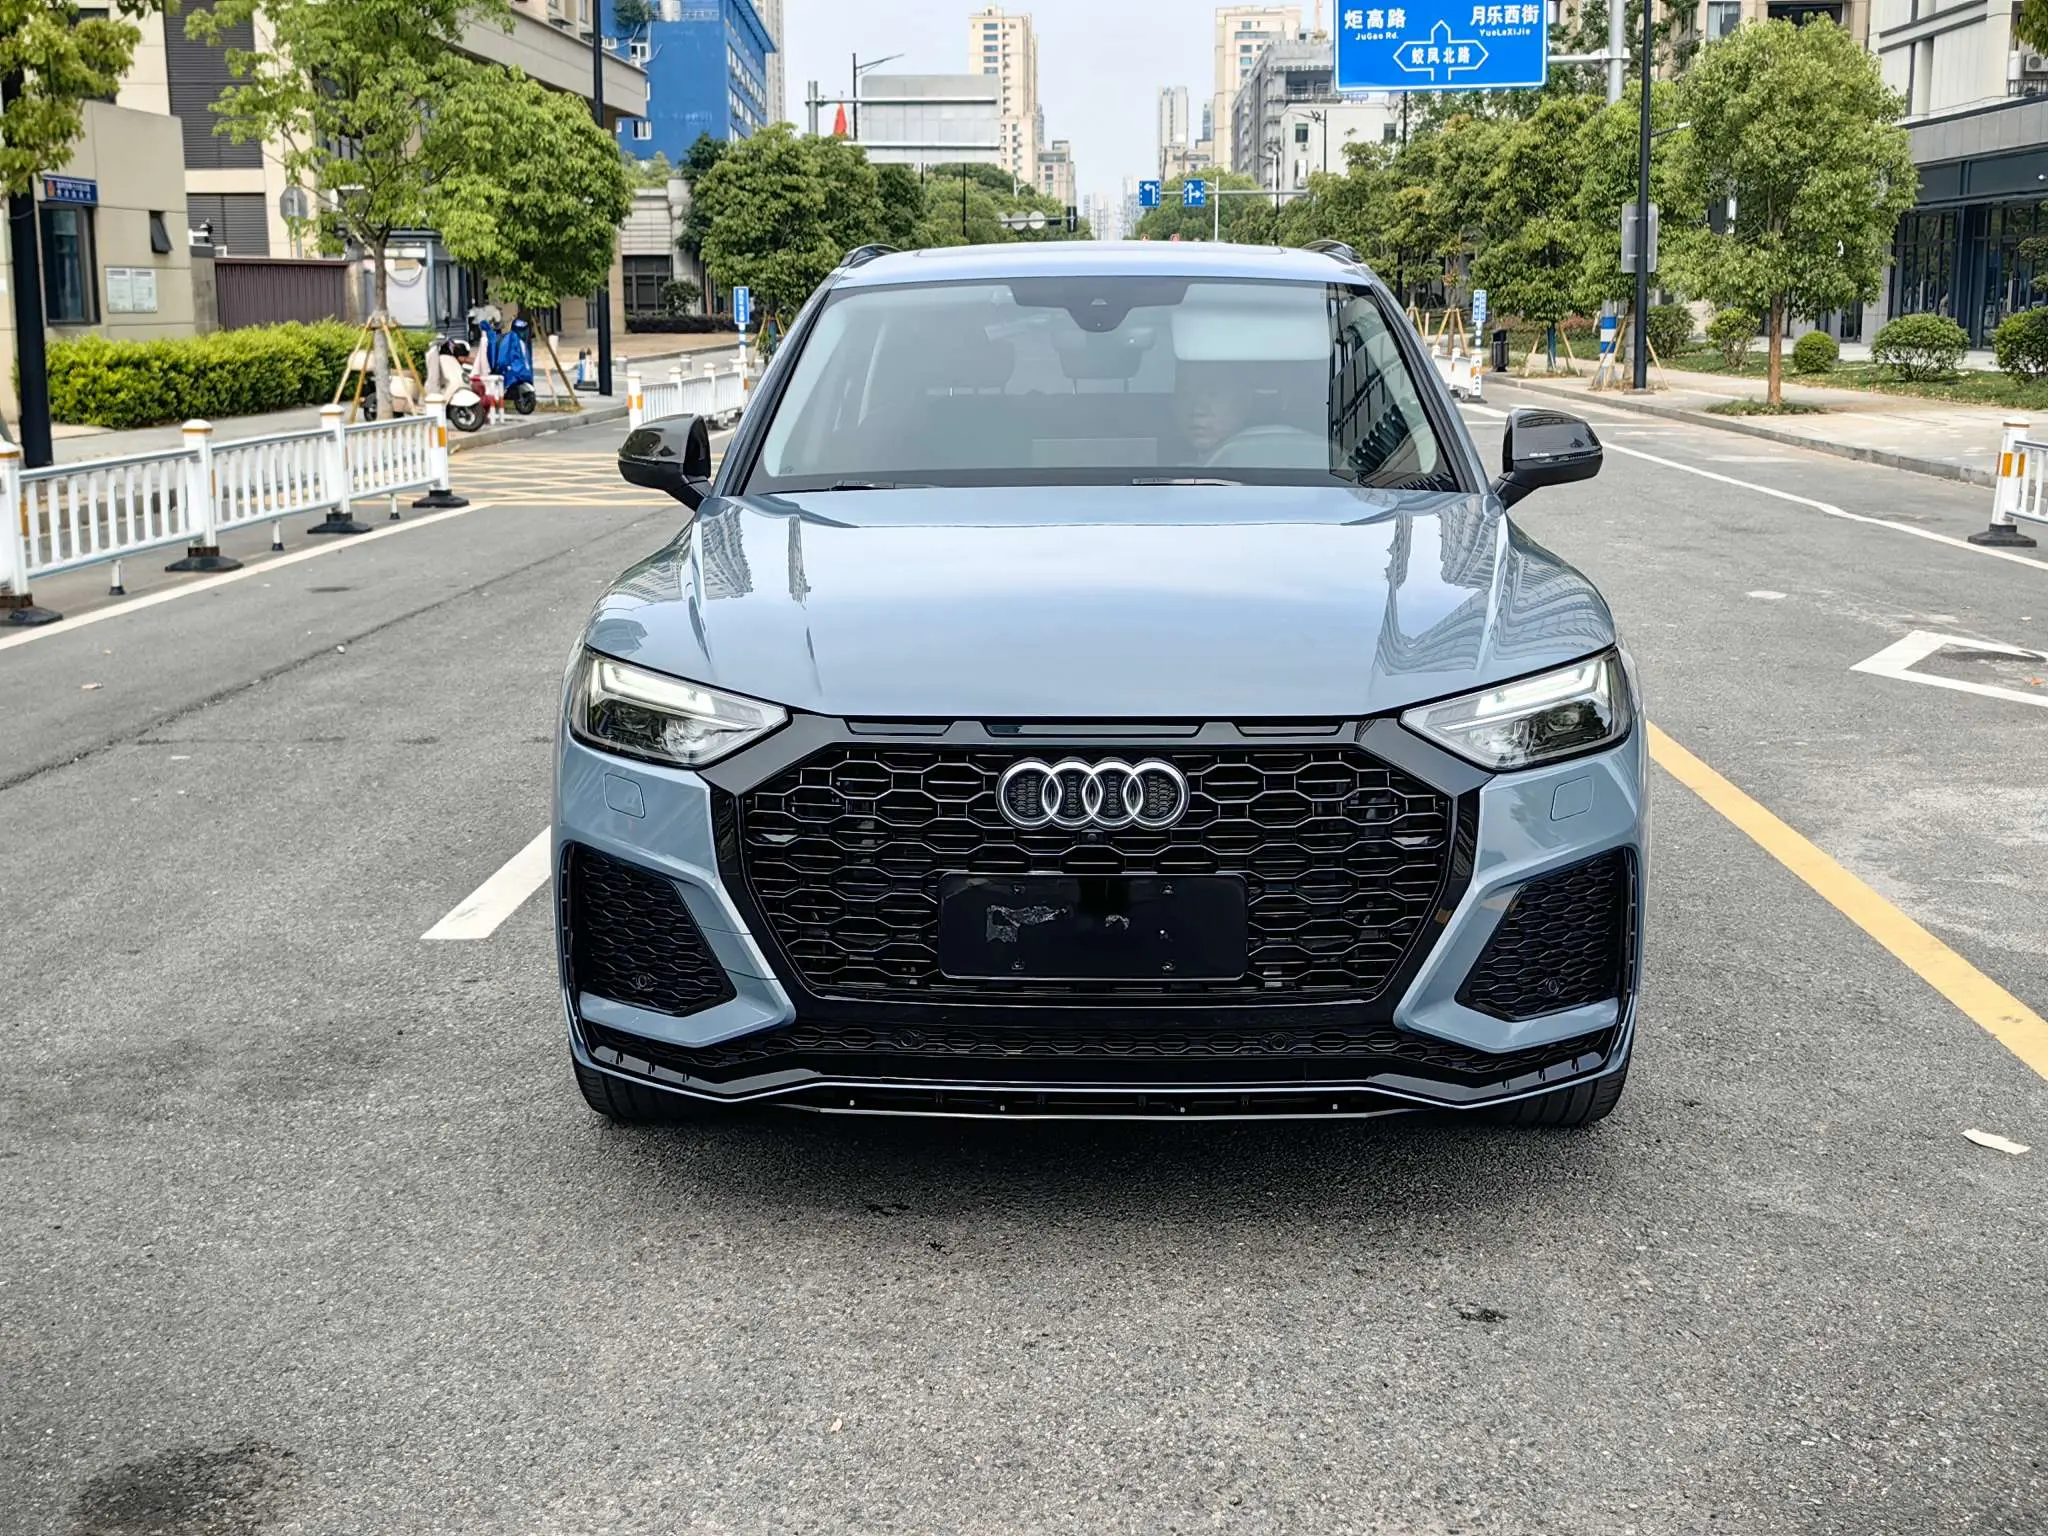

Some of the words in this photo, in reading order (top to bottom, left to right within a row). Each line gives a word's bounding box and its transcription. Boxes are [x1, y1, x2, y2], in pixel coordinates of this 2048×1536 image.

[1344, 8, 1406, 29] 炬高路
[1470, 4, 1540, 26] 月乐西街
[1355, 32, 1383, 40] JuGao
[1385, 31, 1399, 40] Rd.
